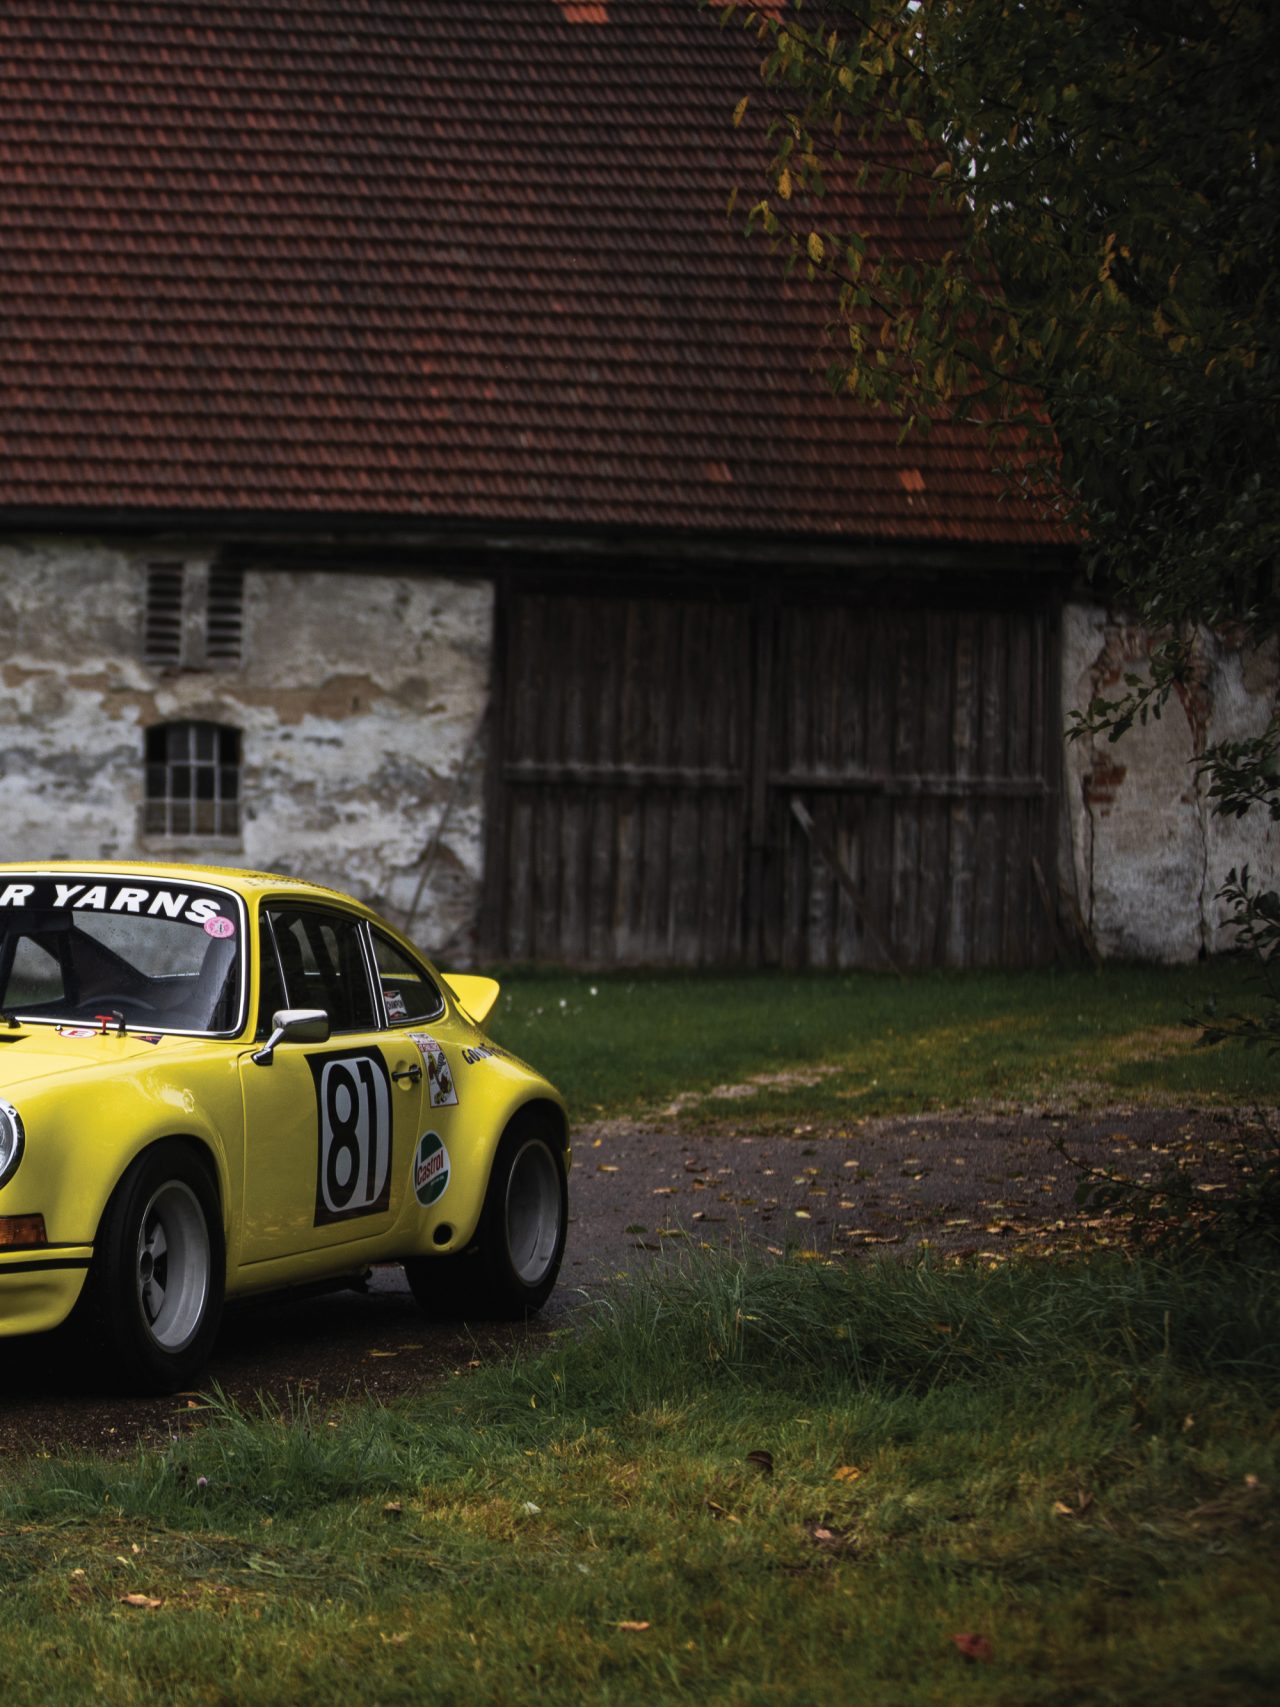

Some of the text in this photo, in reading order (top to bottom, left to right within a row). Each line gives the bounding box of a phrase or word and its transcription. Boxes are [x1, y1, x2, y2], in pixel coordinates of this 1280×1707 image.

[52, 884, 221, 924] YARNS
[327, 1060, 377, 1208] 81
[417, 1149, 444, 1186] Castrol
